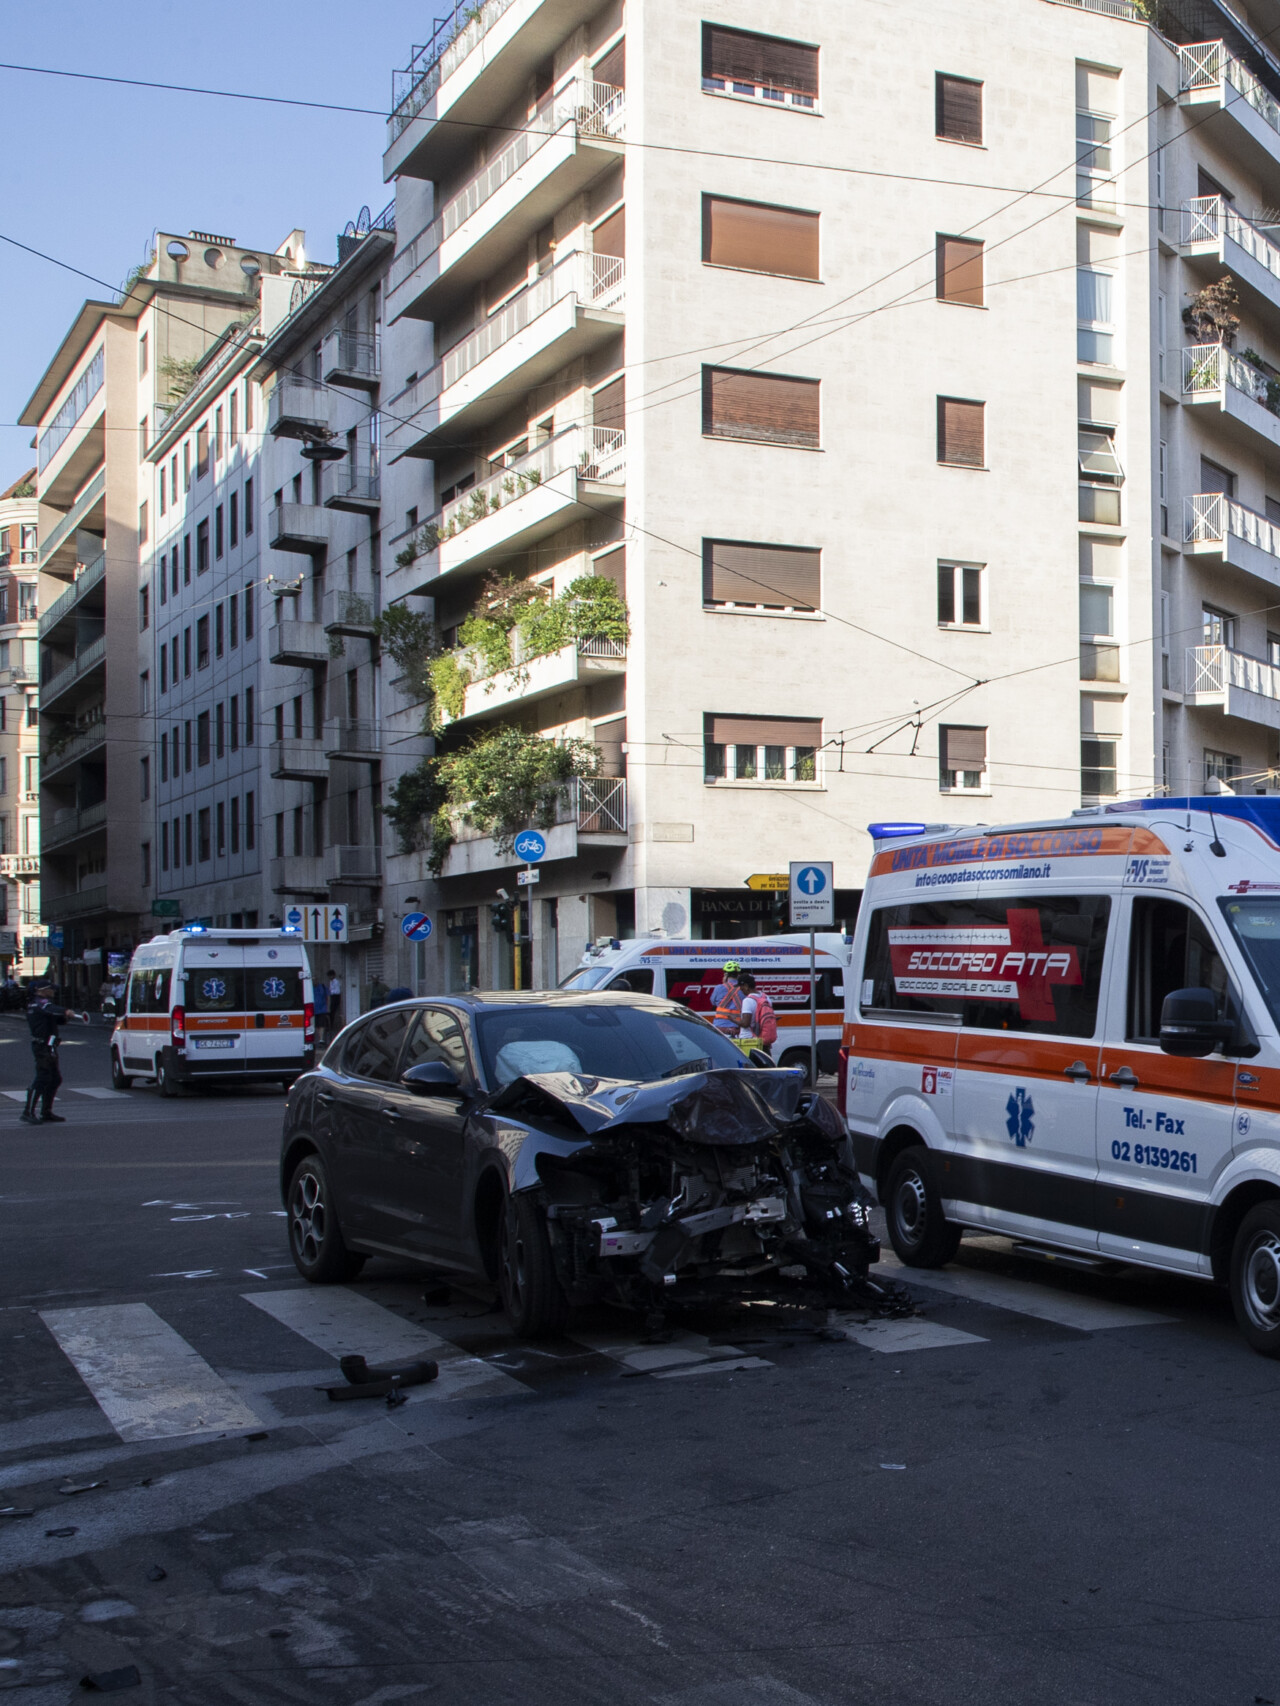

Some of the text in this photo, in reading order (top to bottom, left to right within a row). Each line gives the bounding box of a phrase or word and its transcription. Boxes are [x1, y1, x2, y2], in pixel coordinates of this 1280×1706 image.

[934, 838, 985, 866] MOBILE
[986, 837, 1004, 860] DI
[1005, 829, 1103, 859] SOCCORSO
[915, 863, 1051, 887] info@coopatasoccorsomilano.it
[701, 900, 744, 912] BANCA
[749, 900, 763, 912] DI
[701, 946, 737, 955] MOBILE
[739, 946, 749, 955] DI
[750, 946, 803, 955] SOCCORSO
[907, 951, 1071, 977] SOCCORSO ATA
[683, 984, 803, 995] AT CCORSO
[979, 983, 1012, 994] ONLUS
[1155, 1111, 1185, 1136] Fax
[1111, 1139, 1198, 1174] 02 8139261
